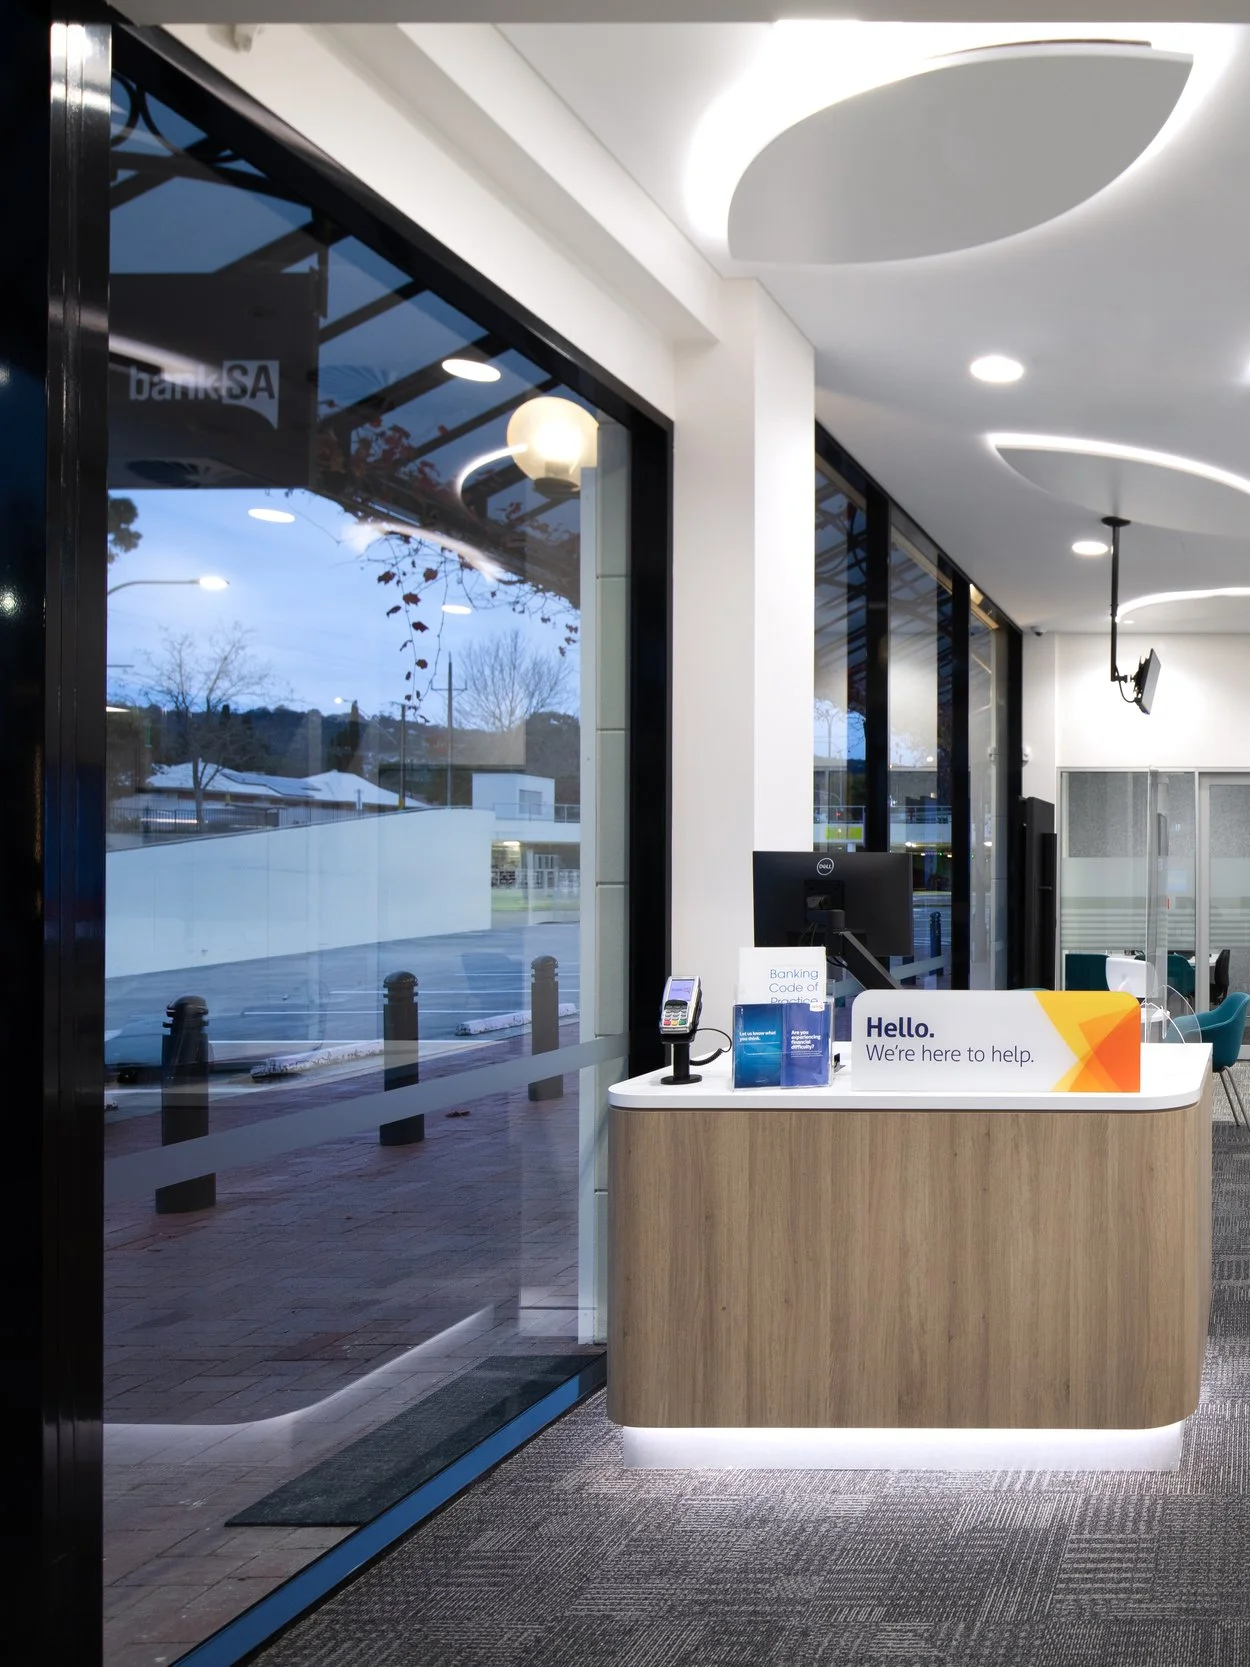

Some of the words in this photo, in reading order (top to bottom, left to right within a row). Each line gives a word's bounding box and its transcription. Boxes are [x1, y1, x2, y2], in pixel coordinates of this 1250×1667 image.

[770, 969, 819, 980] Banking
[769, 983, 803, 993] Code
[807, 982, 818, 992] of
[867, 1017, 935, 1038] Hello.
[866, 1044, 915, 1062] We're
[922, 1045, 961, 1062] here
[967, 1047, 985, 1062] to
[992, 1046, 1034, 1067] help.
